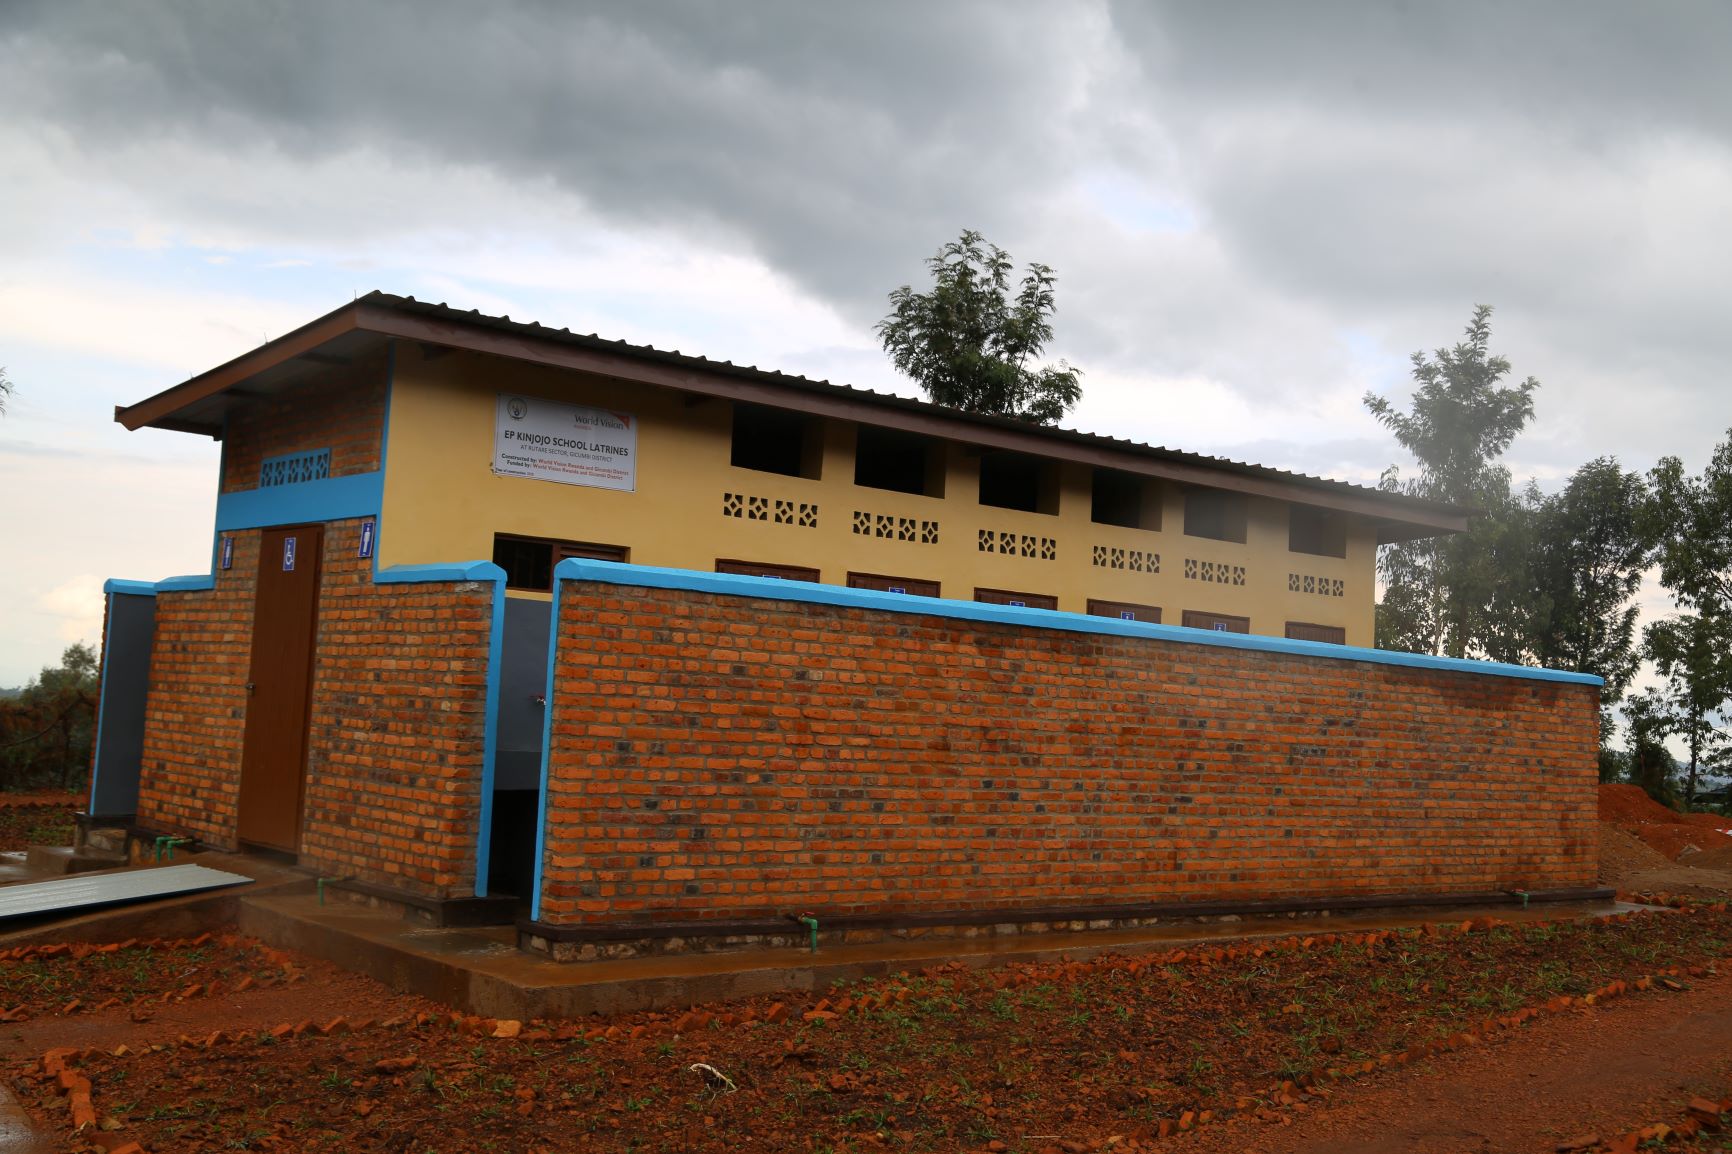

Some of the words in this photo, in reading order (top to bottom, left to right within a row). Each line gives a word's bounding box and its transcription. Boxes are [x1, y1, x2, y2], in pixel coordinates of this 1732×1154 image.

[574, 414, 598, 426] World
[600, 417, 624, 430] Vision
[504, 430, 514, 439] EP
[517, 432, 550, 446] KINJOJO
[553, 438, 588, 450] SCHOOL
[590, 443, 628, 456] LATRINES
[502, 453, 530, 462] Constructed
